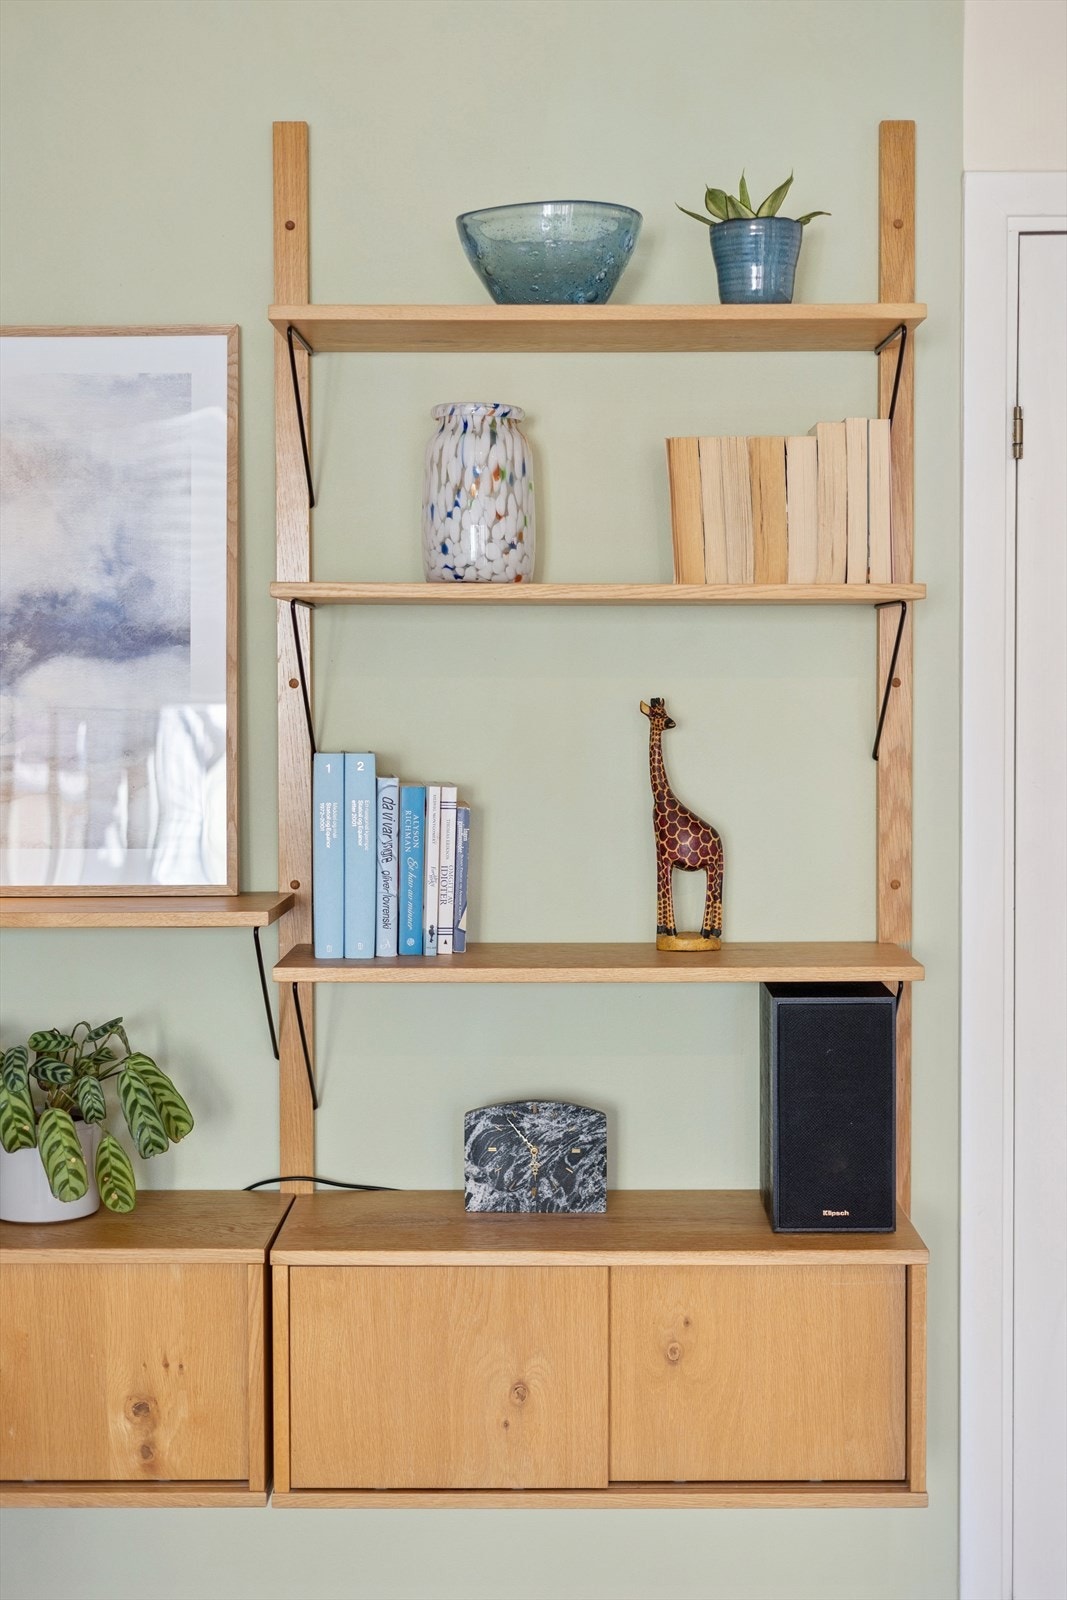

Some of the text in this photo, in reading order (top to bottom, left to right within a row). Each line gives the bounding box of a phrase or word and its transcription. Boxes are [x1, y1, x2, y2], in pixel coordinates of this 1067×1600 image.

[325, 763, 331, 774] 1
[356, 761, 365, 772] 2
[382, 796, 396, 810] da
[382, 812, 396, 822] vi
[382, 822, 393, 838] var
[407, 872, 416, 888] hav
[440, 866, 448, 906] IDIOTER
[381, 870, 392, 930] oliver lovrenski
[407, 888, 413, 900] av
[448, 896, 453, 904] AV
